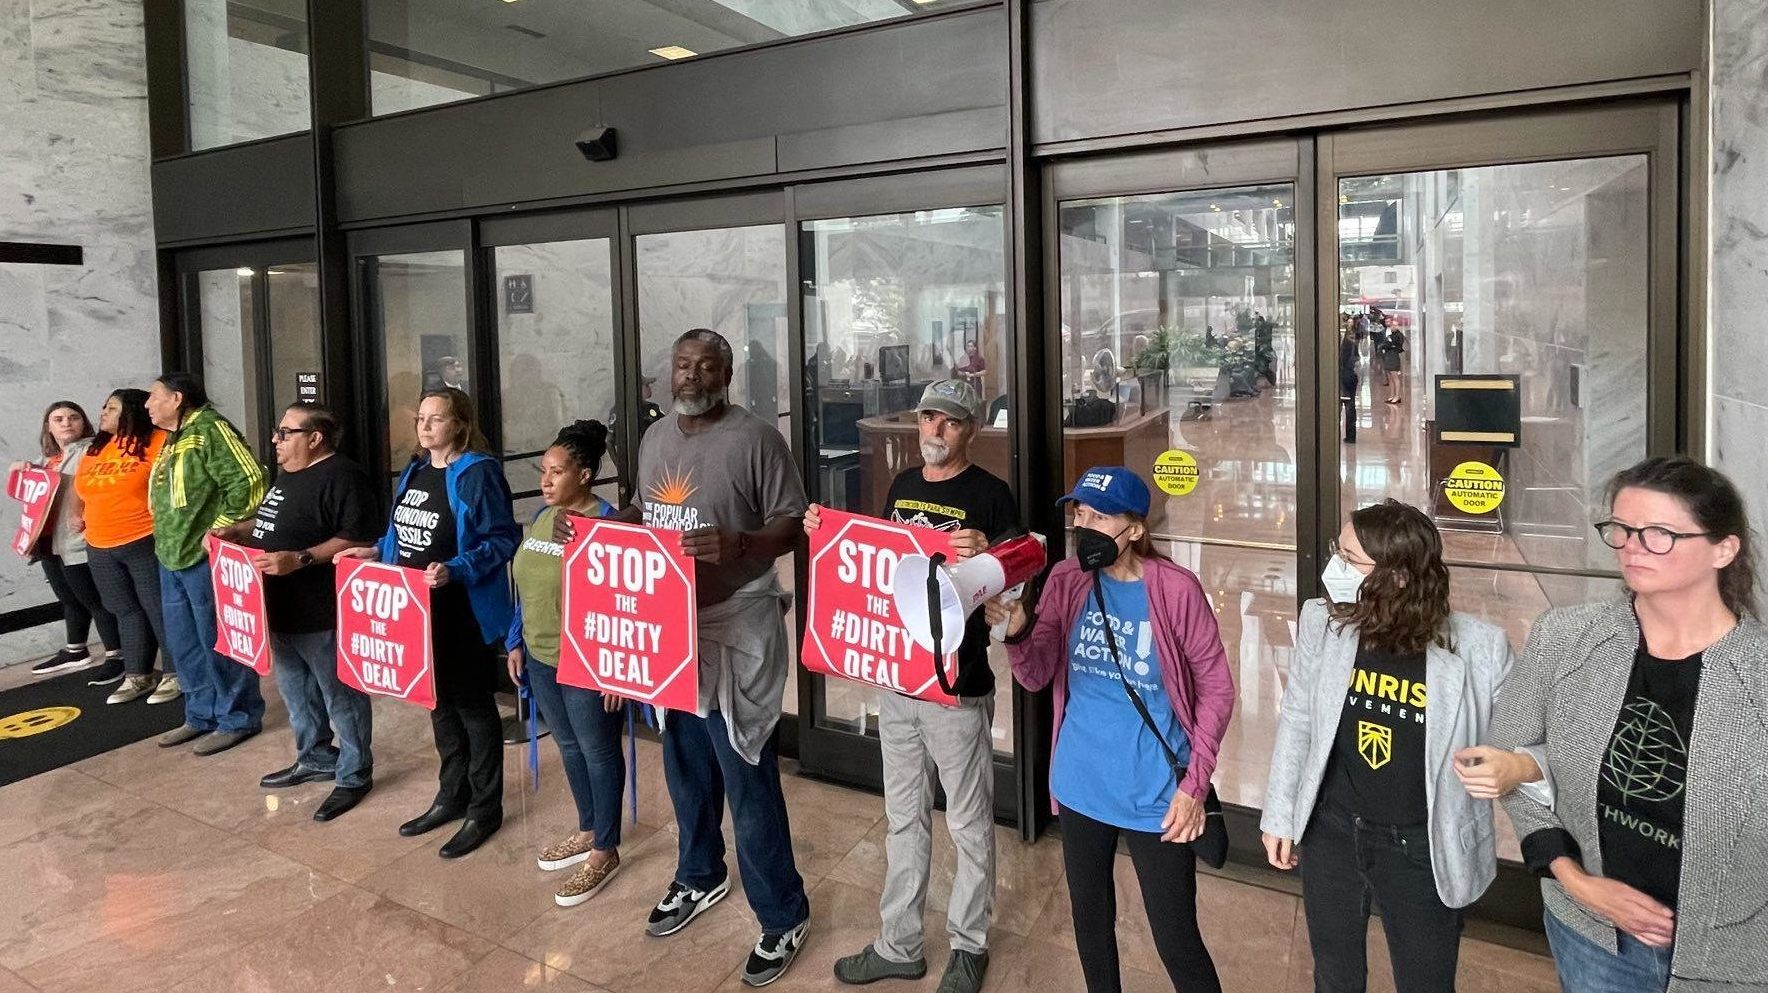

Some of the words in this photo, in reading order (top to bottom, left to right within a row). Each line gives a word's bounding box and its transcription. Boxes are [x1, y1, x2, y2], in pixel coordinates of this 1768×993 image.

[1154, 465, 1198, 475] CAUTION
[1158, 475, 1195, 483] AUTOMATIC
[1447, 479, 1503, 490] CAUTION
[401, 488, 429, 508] STOP
[1451, 490, 1499, 499] AUTOMATIC
[1463, 499, 1486, 507] DOOR
[393, 504, 440, 530] FUNDING
[653, 503, 699, 523] POPULAR
[394, 523, 432, 546] OSSILS
[219, 556, 254, 594] STOP
[587, 542, 667, 595] STOP
[837, 538, 900, 596] STO
[351, 578, 409, 622] STOP
[614, 593, 638, 615] THE
[866, 594, 890, 618] THE
[223, 604, 256, 636] #DIRTY
[370, 619, 387, 637] THE
[584, 611, 662, 654] #DIRTY
[1121, 621, 1135, 636] &
[230, 629, 255, 658] DEAL
[351, 632, 405, 667] #DIRTY
[831, 609, 915, 661] #DIRTY
[362, 663, 402, 692] DEAL
[598, 647, 654, 687] DEAL
[844, 648, 907, 692] DEAL
[1349, 695, 1425, 724] VEMEN
[1600, 802, 1681, 849] HWORK
